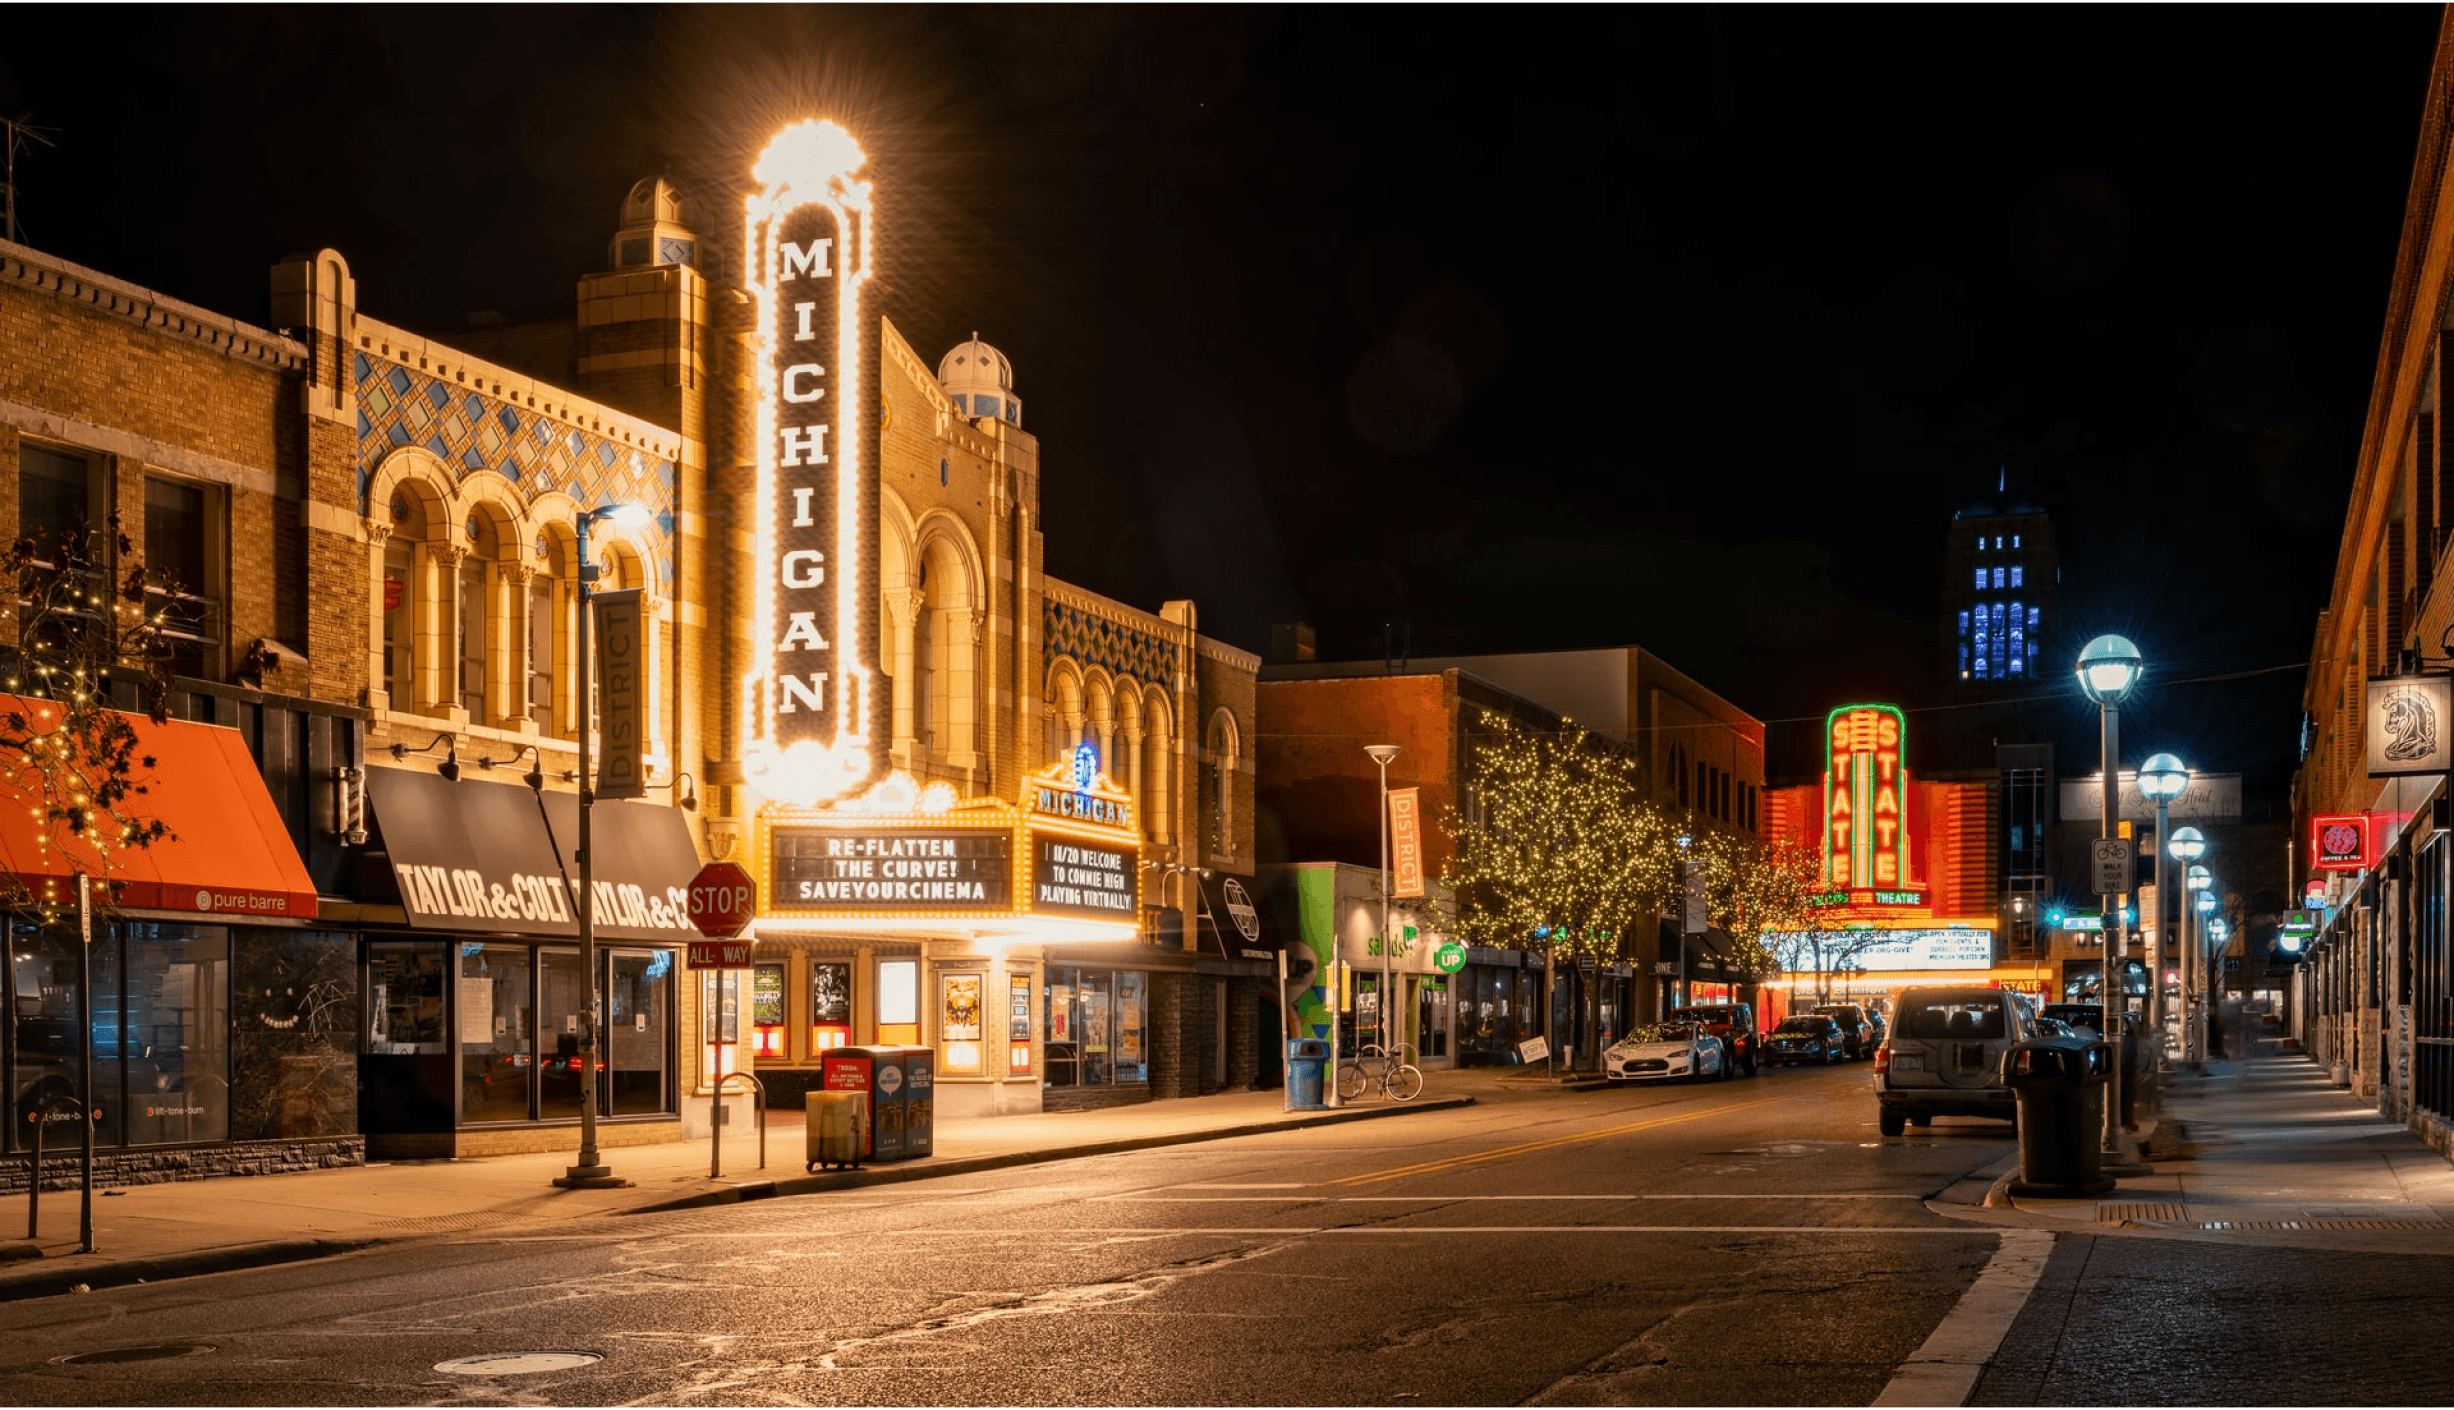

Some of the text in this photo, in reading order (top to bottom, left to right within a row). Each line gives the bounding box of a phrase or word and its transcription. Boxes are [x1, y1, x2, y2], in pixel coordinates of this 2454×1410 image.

[778, 237, 833, 714] MICHIGAN
[606, 610, 631, 779] DISTRICT
[1038, 787, 1128, 827] MICHIGAN
[1832, 719, 1850, 883] STATE
[1875, 719, 1898, 881] STATE
[828, 838, 956, 857] RE-FLATTEN
[1396, 799, 1416, 888] DISTRICT
[1081, 847, 1122, 870] WELCOME
[2104, 862, 2122, 870] WALK
[836, 860, 957, 878] THE CURVE!
[1053, 866, 1125, 890] TO CONNIE HIGH
[2104, 872, 2122, 880] YOUR
[800, 881, 985, 899] SAVEYOURCINEMA
[1041, 884, 1081, 904] PLAYING
[2104, 881, 2122, 889] BIKE
[214, 892, 286, 911] pure barre
[691, 886, 749, 915] STOP
[1875, 891, 1920, 905] THEATRE
[724, 946, 749, 963] WAY
[1441, 955, 1460, 966] UP
